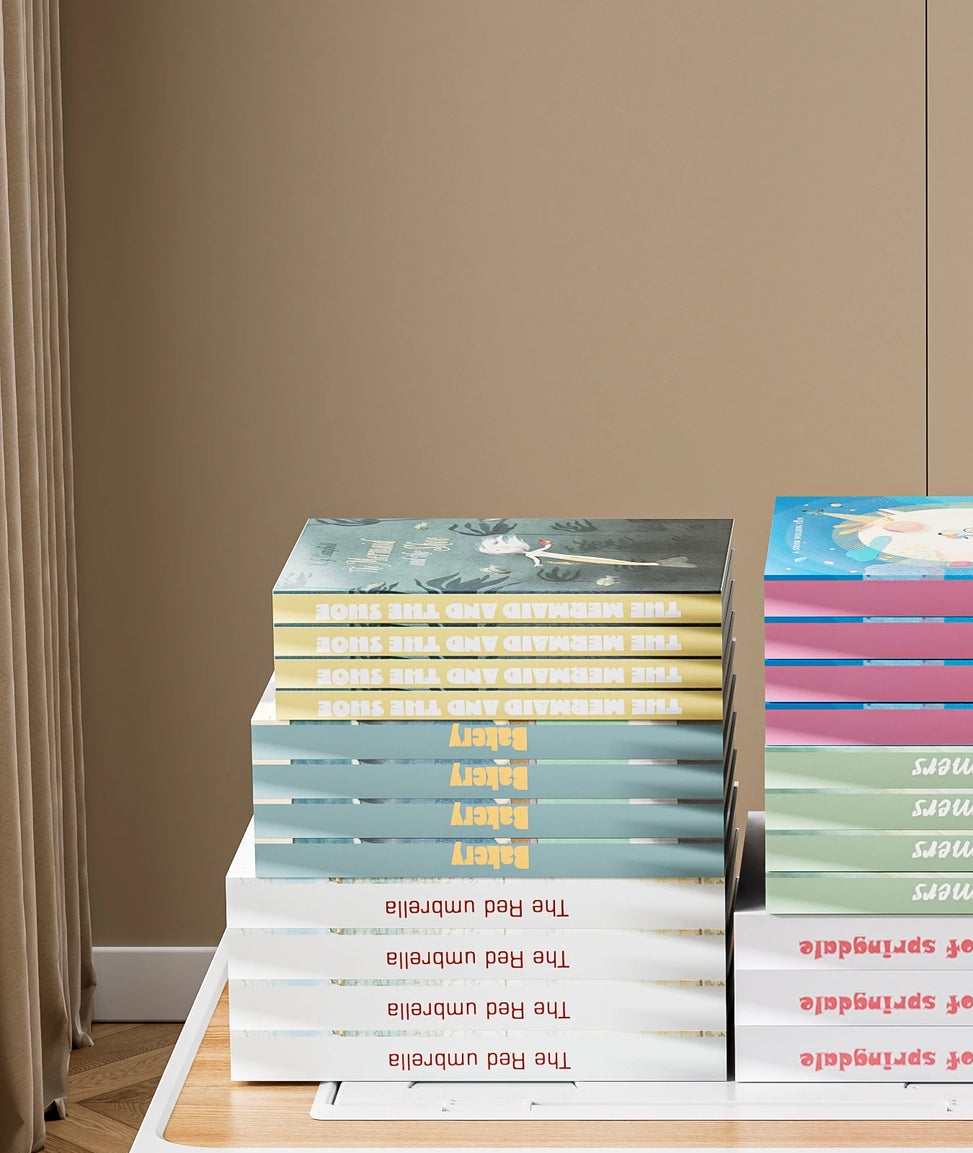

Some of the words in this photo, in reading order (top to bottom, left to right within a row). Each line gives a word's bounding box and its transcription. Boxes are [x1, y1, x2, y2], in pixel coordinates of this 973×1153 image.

[314, 603, 383, 622] SHOE
[387, 602, 441, 620] THE
[445, 602, 498, 620] AND
[502, 601, 624, 619] MERMAID
[630, 601, 682, 619] THE
[315, 635, 383, 655] SHOE
[388, 635, 441, 653] THE
[445, 635, 499, 653] AND
[502, 634, 625, 652] MERMAID
[630, 634, 682, 651] THE
[316, 668, 384, 687] SHOE
[389, 667, 442, 685] THE
[446, 667, 499, 685] AND
[503, 666, 625, 685] MERMAID
[631, 666, 682, 684] THE
[317, 699, 385, 718] SHOE
[389, 699, 442, 717] THE
[447, 699, 500, 717] AND
[503, 698, 625, 716] MERMAID
[631, 697, 683, 715] THE
[449, 722, 528, 751] Bakery
[450, 763, 529, 791] Bakery
[450, 802, 529, 830] Bakery
[451, 841, 529, 870] Bakery
[385, 899, 475, 917] umbrella
[484, 899, 523, 918] Red
[532, 899, 566, 918] The
[799, 935, 936, 960] springdale
[386, 951, 476, 969] umbrella
[485, 950, 524, 969] Red
[533, 951, 568, 969] The
[387, 1002, 477, 1019] umbrella
[486, 1001, 525, 1020] Red
[534, 1002, 569, 1020] The
[799, 991, 936, 1016] springdale
[388, 1053, 478, 1070] umbrella
[487, 1052, 525, 1071] Red
[535, 1052, 568, 1070] The
[799, 1047, 936, 1072] springdale
